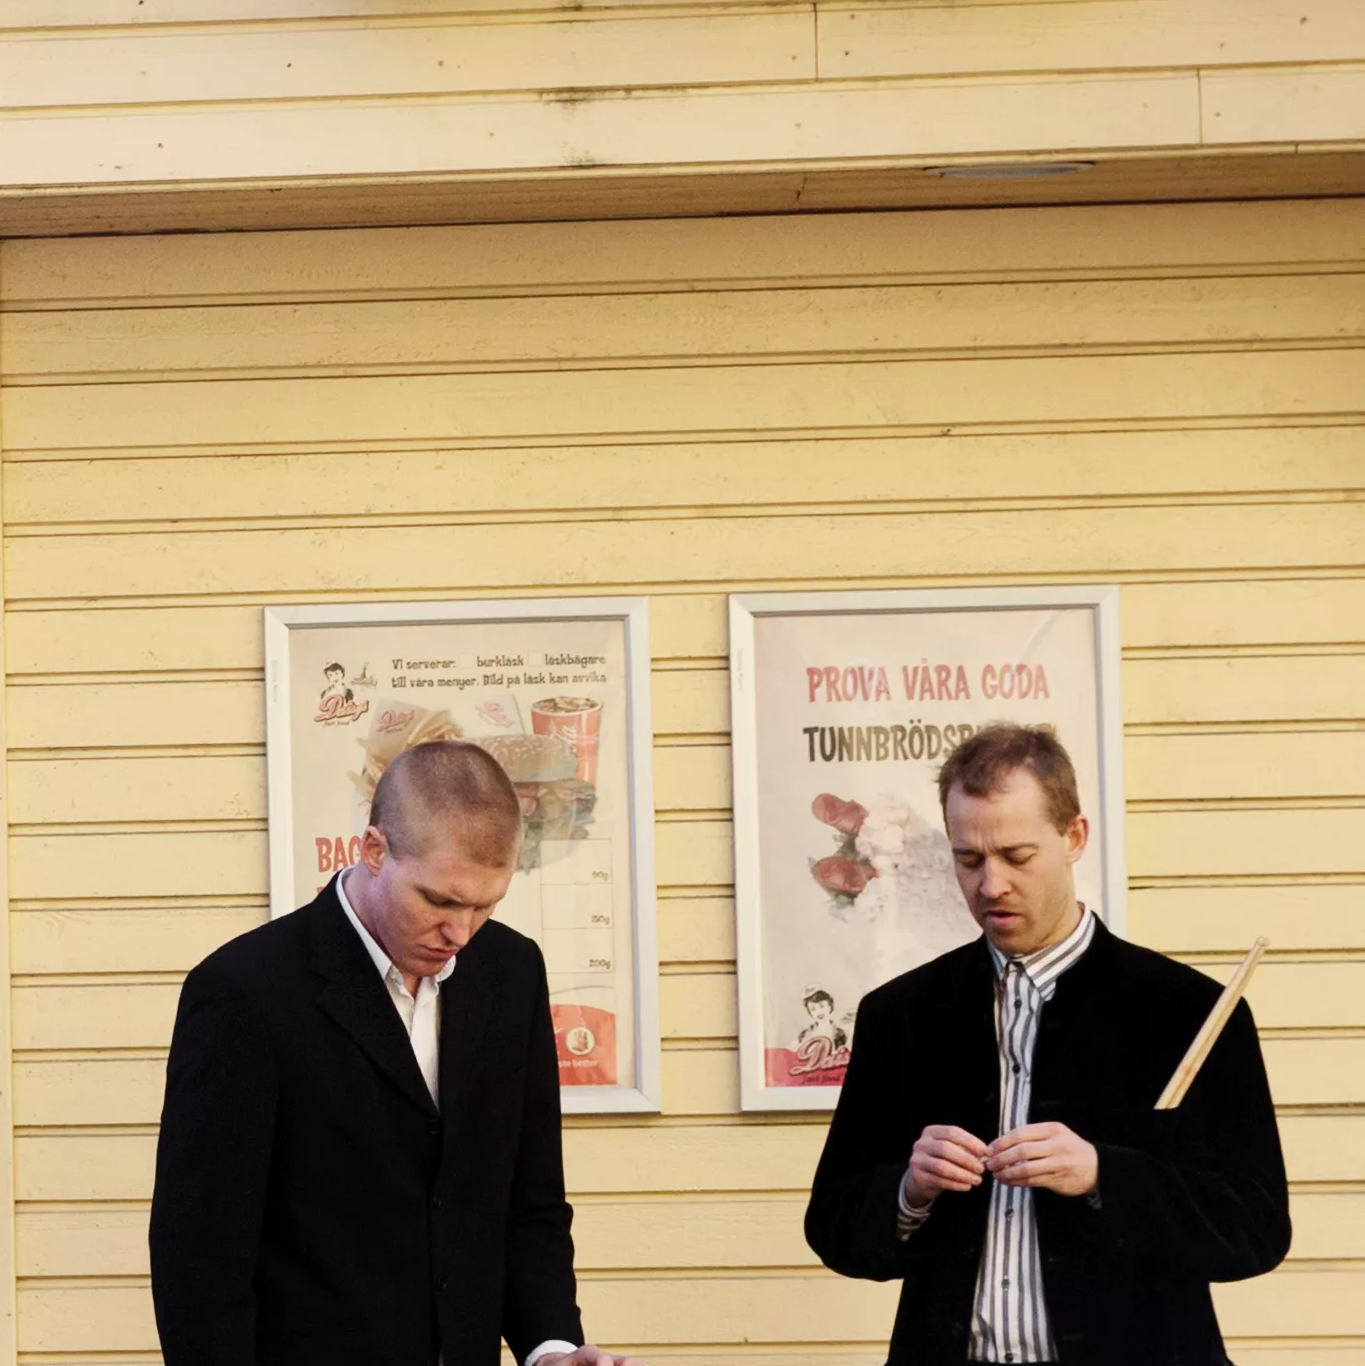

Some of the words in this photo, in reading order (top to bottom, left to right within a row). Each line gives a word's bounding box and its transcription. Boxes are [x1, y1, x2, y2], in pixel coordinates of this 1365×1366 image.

[391, 658, 403, 669] Vi
[391, 675, 407, 688] till
[482, 673, 504, 686] Bild
[506, 675, 521, 689] på
[549, 671, 569, 684] kan
[806, 666, 893, 703] PROVA
[901, 657, 972, 702] VÅRA
[980, 663, 1051, 701] GODA
